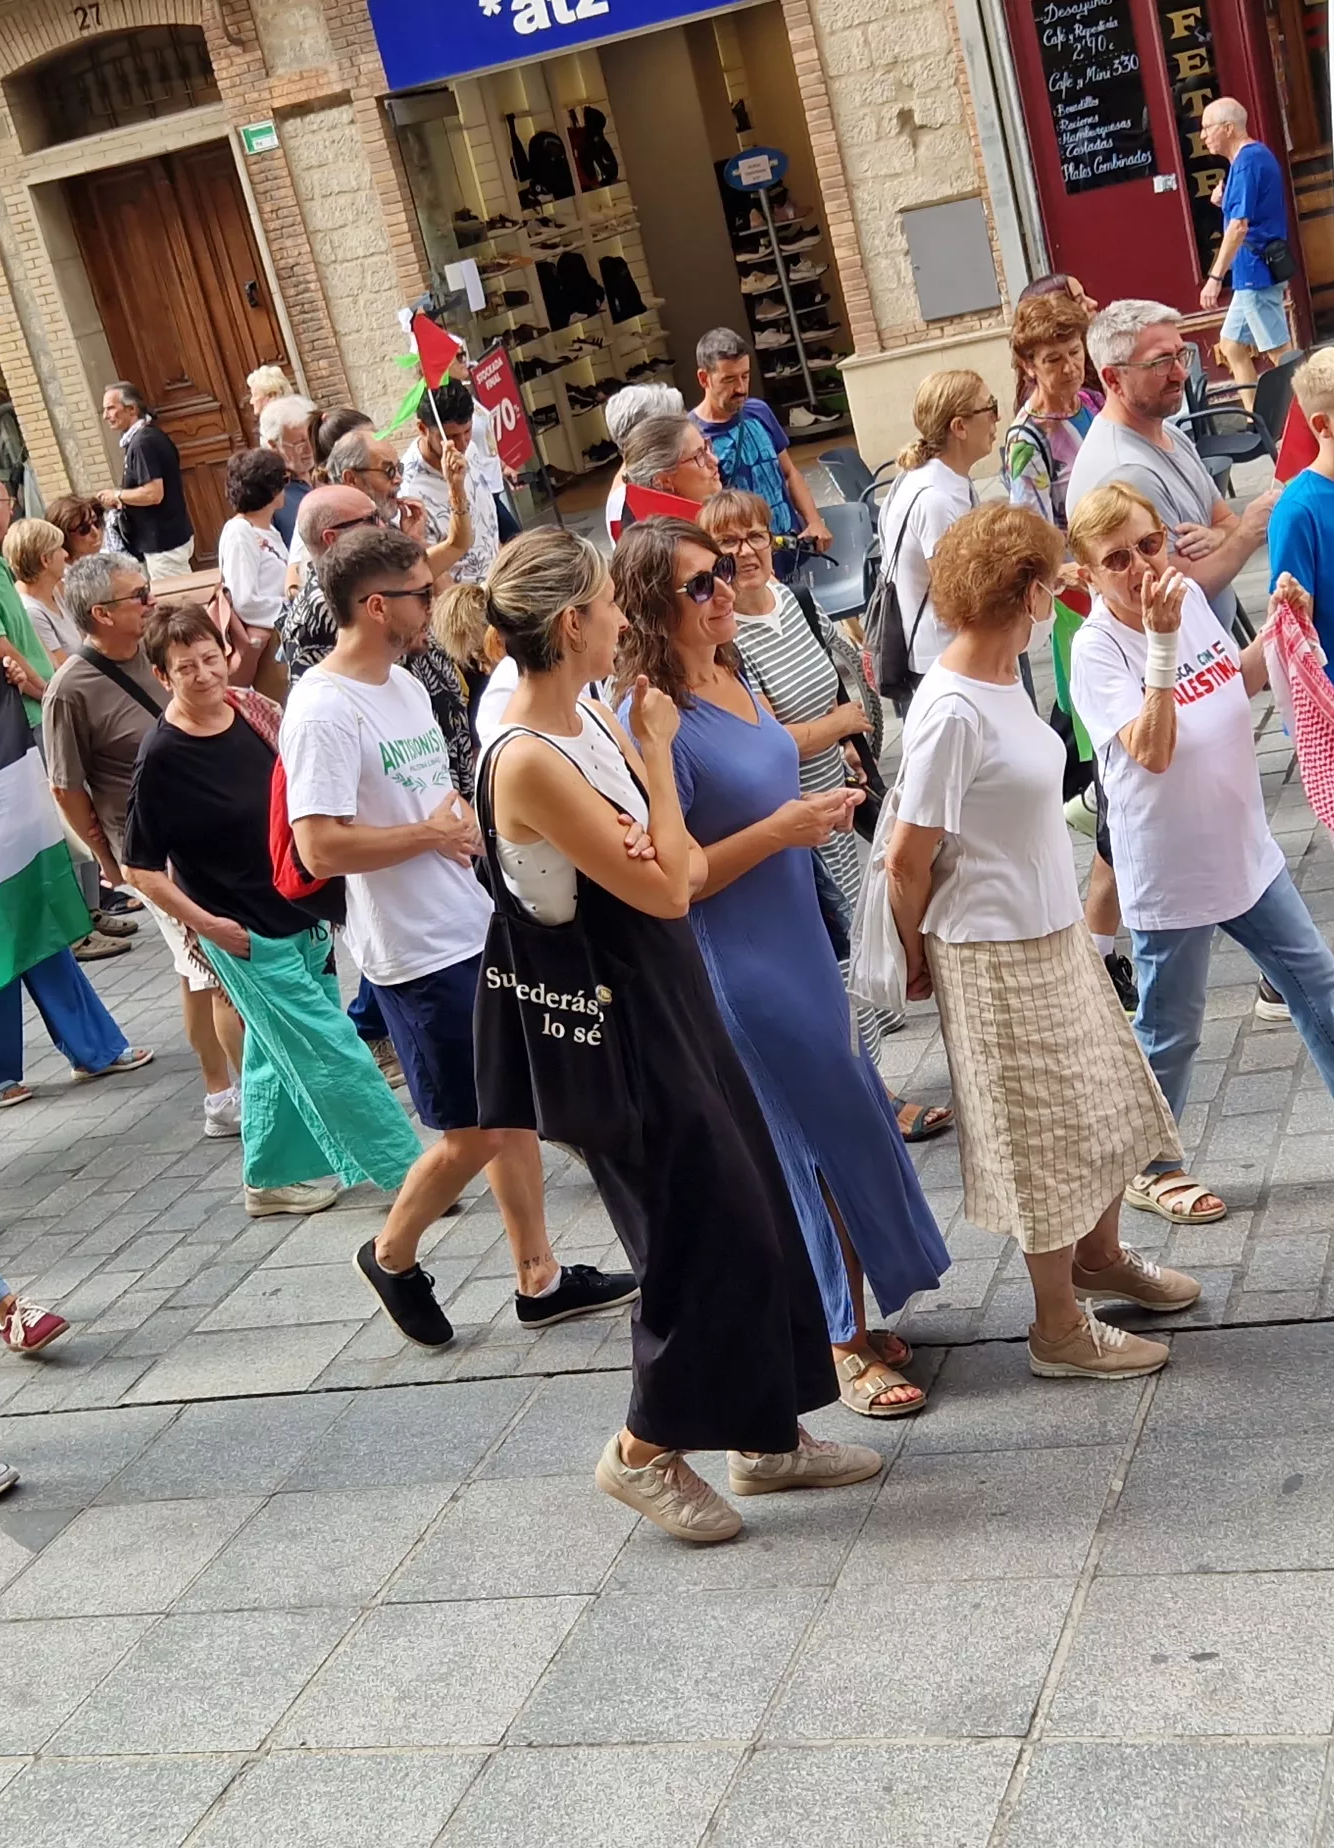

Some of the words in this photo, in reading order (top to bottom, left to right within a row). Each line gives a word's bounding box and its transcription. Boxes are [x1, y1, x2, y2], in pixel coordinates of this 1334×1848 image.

[74, 3, 102, 31] 27
[1048, 71, 1073, 100] Café
[1085, 65, 1111, 84] Mini
[1059, 114, 1099, 132] Raciones
[1062, 119, 1132, 144] Hamburguesas
[1064, 138, 1114, 158] Tostadas
[1061, 162, 1093, 182] Platos
[1093, 149, 1153, 174] Combinados
[542, 1013, 566, 1039] lo
[573, 1024, 603, 1046] sé
